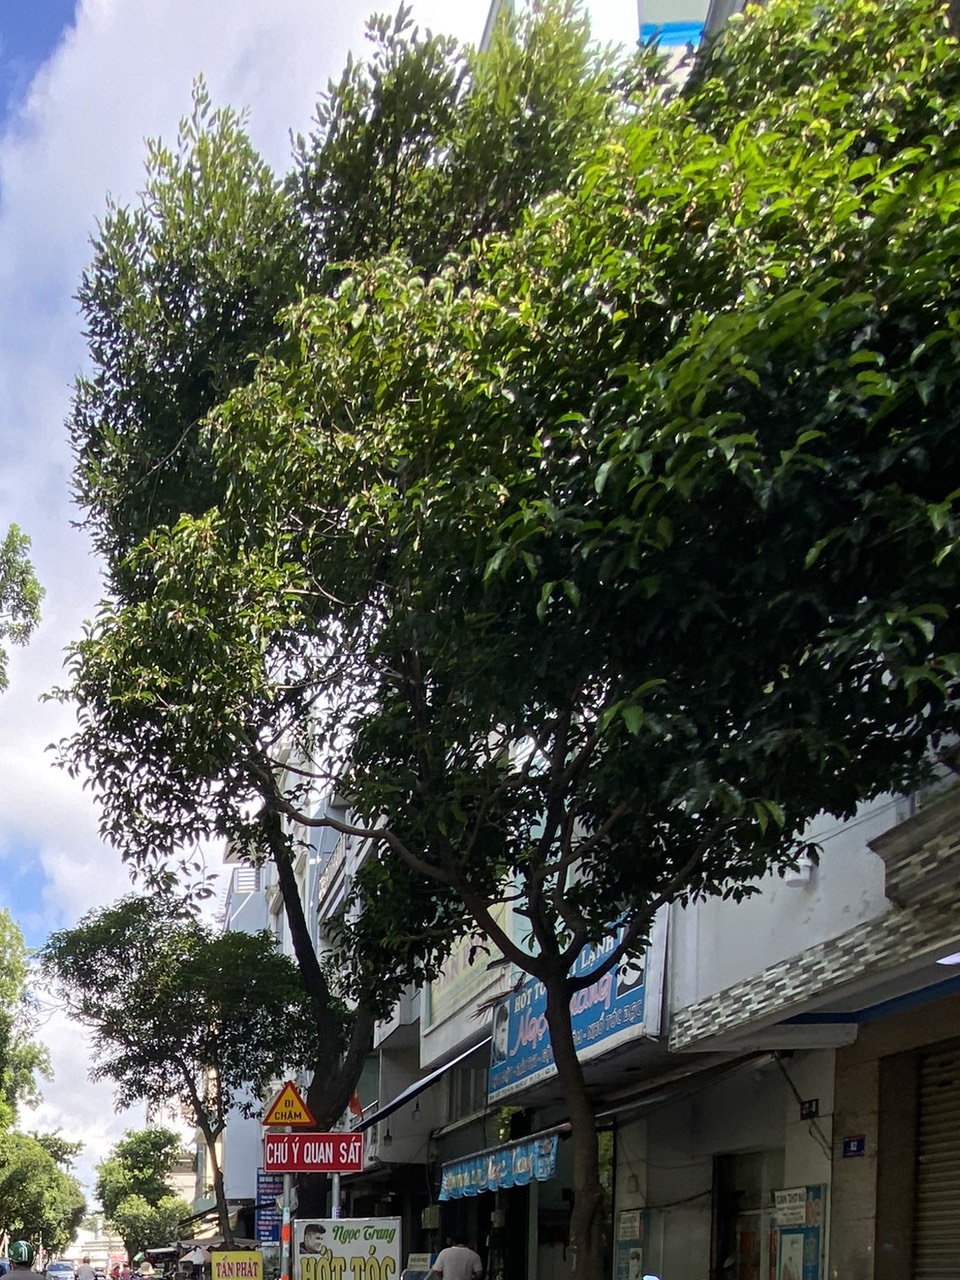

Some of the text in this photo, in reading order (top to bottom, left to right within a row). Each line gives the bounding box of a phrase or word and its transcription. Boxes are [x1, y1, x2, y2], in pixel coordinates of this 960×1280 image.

[284, 1099, 294, 1108] ĐI
[274, 1110, 302, 1122] CHẬM
[266, 1136, 361, 1164] CHÚ Ý QUAN SÁT
[332, 1225, 396, 1244] Ngọc Trang
